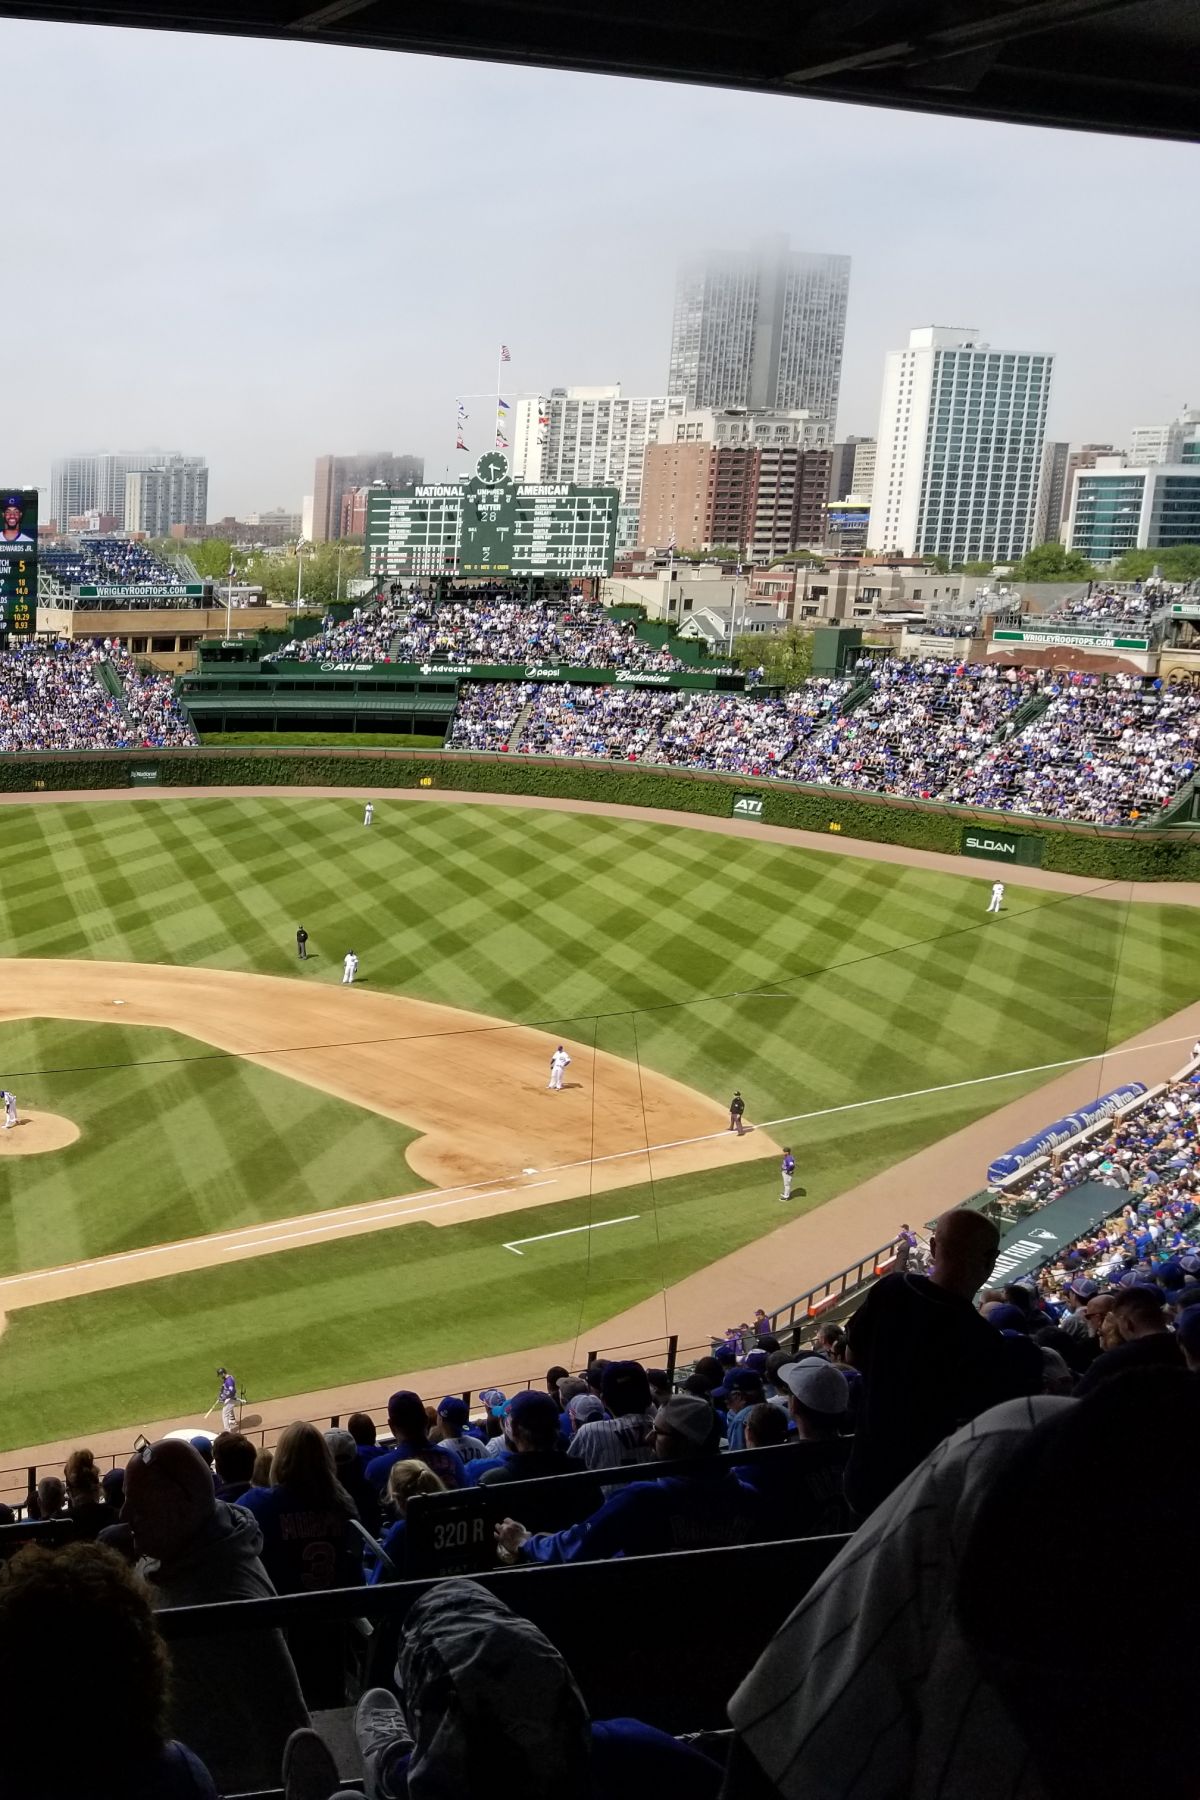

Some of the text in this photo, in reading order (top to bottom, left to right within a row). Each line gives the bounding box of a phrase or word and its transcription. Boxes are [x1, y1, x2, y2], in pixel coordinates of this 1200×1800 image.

[415, 486, 464, 496] NATIONAL
[516, 485, 568, 496] AMERICAN
[481, 512, 496, 521] 28
[482, 552, 490, 561] 2
[19, 560, 25, 572] 5
[96, 587, 186, 596] WRIGLEYROOFTOPS.COM
[1023, 633, 1115, 646] WRIGLEYROOFTOPS.COM
[537, 669, 560, 677] pepsi
[615, 670, 670, 682] Budweiser
[734, 799, 762, 812] ATI
[966, 838, 1015, 853] SLOAN
[434, 1518, 484, 1550] 320 R
